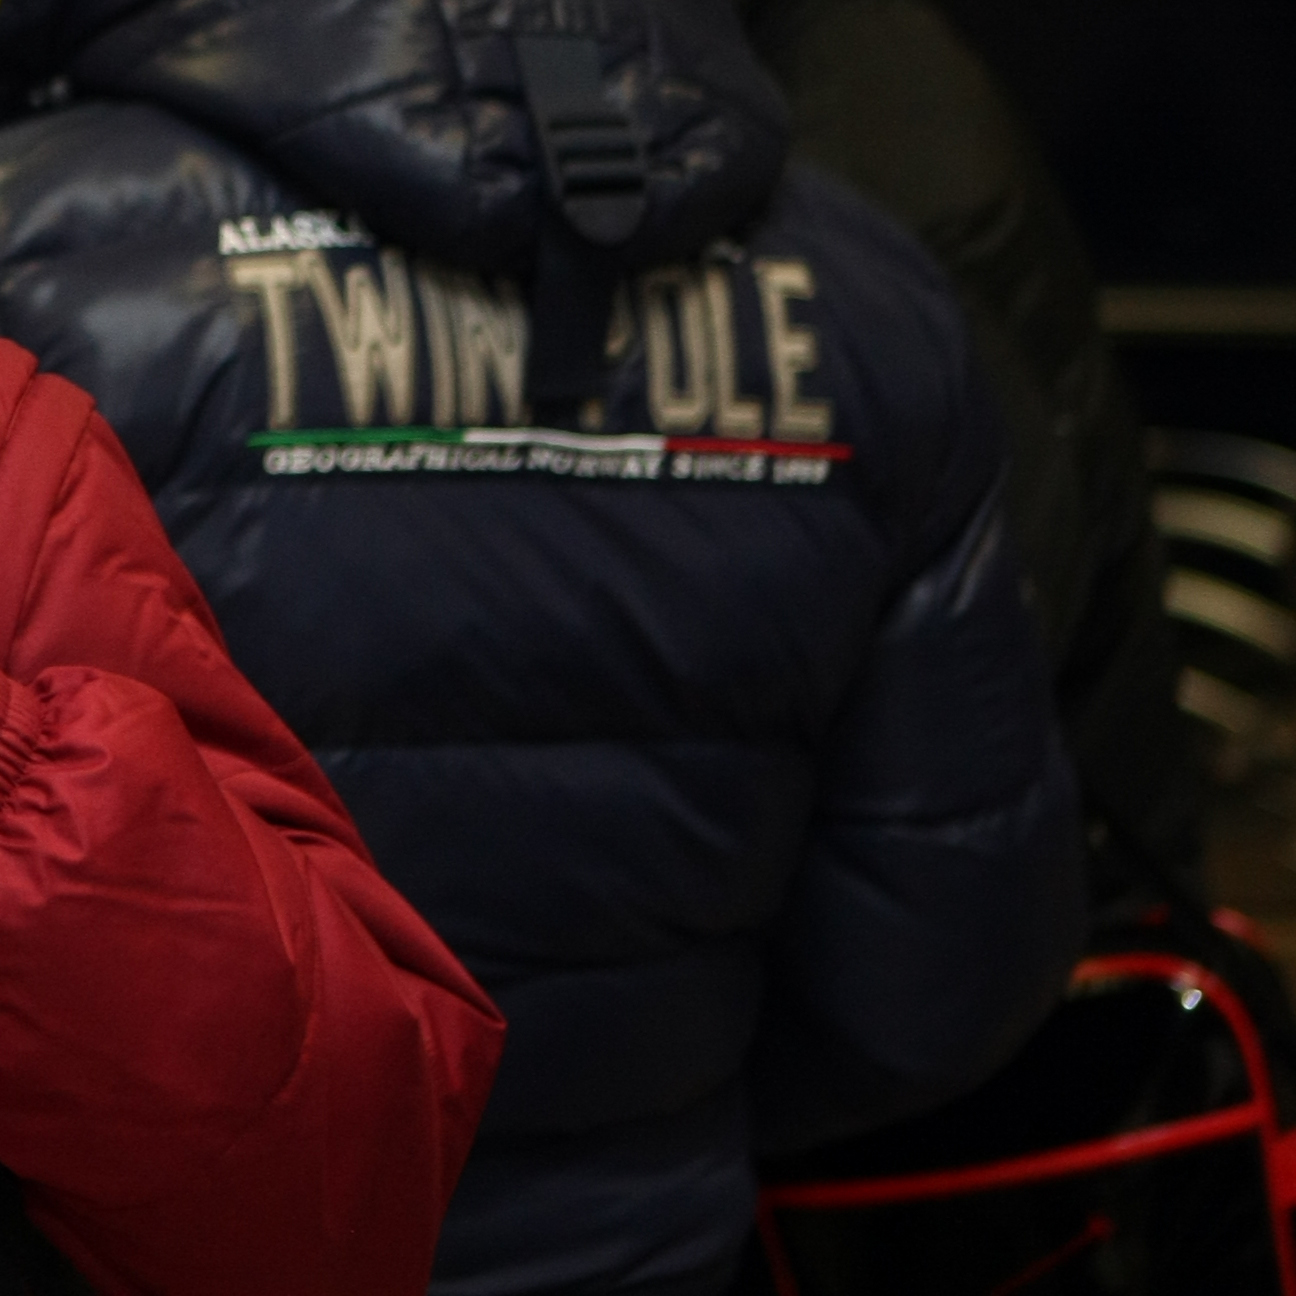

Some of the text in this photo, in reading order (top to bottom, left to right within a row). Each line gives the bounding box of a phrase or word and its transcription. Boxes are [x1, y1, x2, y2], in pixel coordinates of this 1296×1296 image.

[228, 249, 833, 442] TWIN OLE
[670, 453, 766, 481] SINCE
